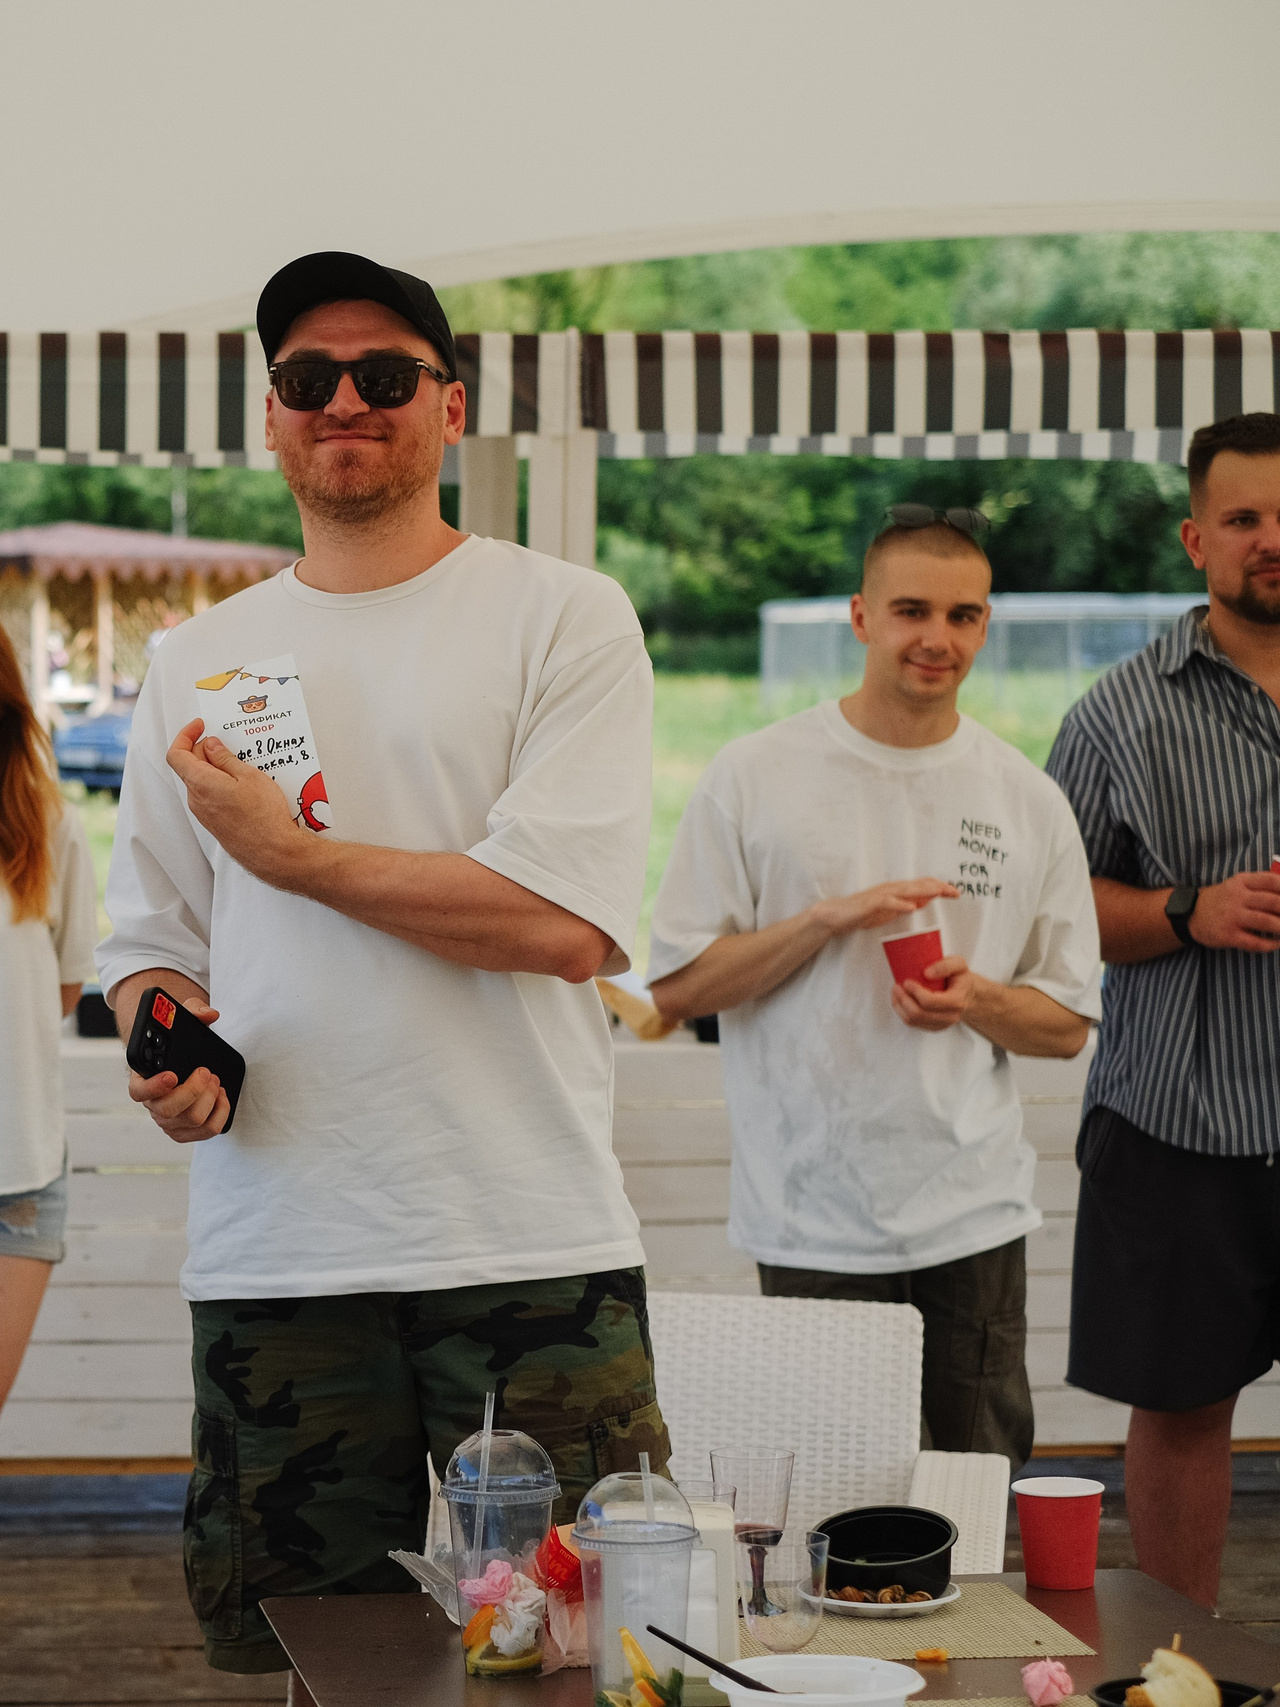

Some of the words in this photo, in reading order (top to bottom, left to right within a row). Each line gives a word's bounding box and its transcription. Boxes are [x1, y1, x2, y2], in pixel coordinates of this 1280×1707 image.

[223, 710, 292, 730] СЕРТИФИКАТ
[236, 749, 252, 761] фе
[267, 737, 305, 754] Окнах
[961, 817, 1001, 840] NEED
[958, 837, 1008, 865] MONEY
[960, 863, 989, 878] FOR
